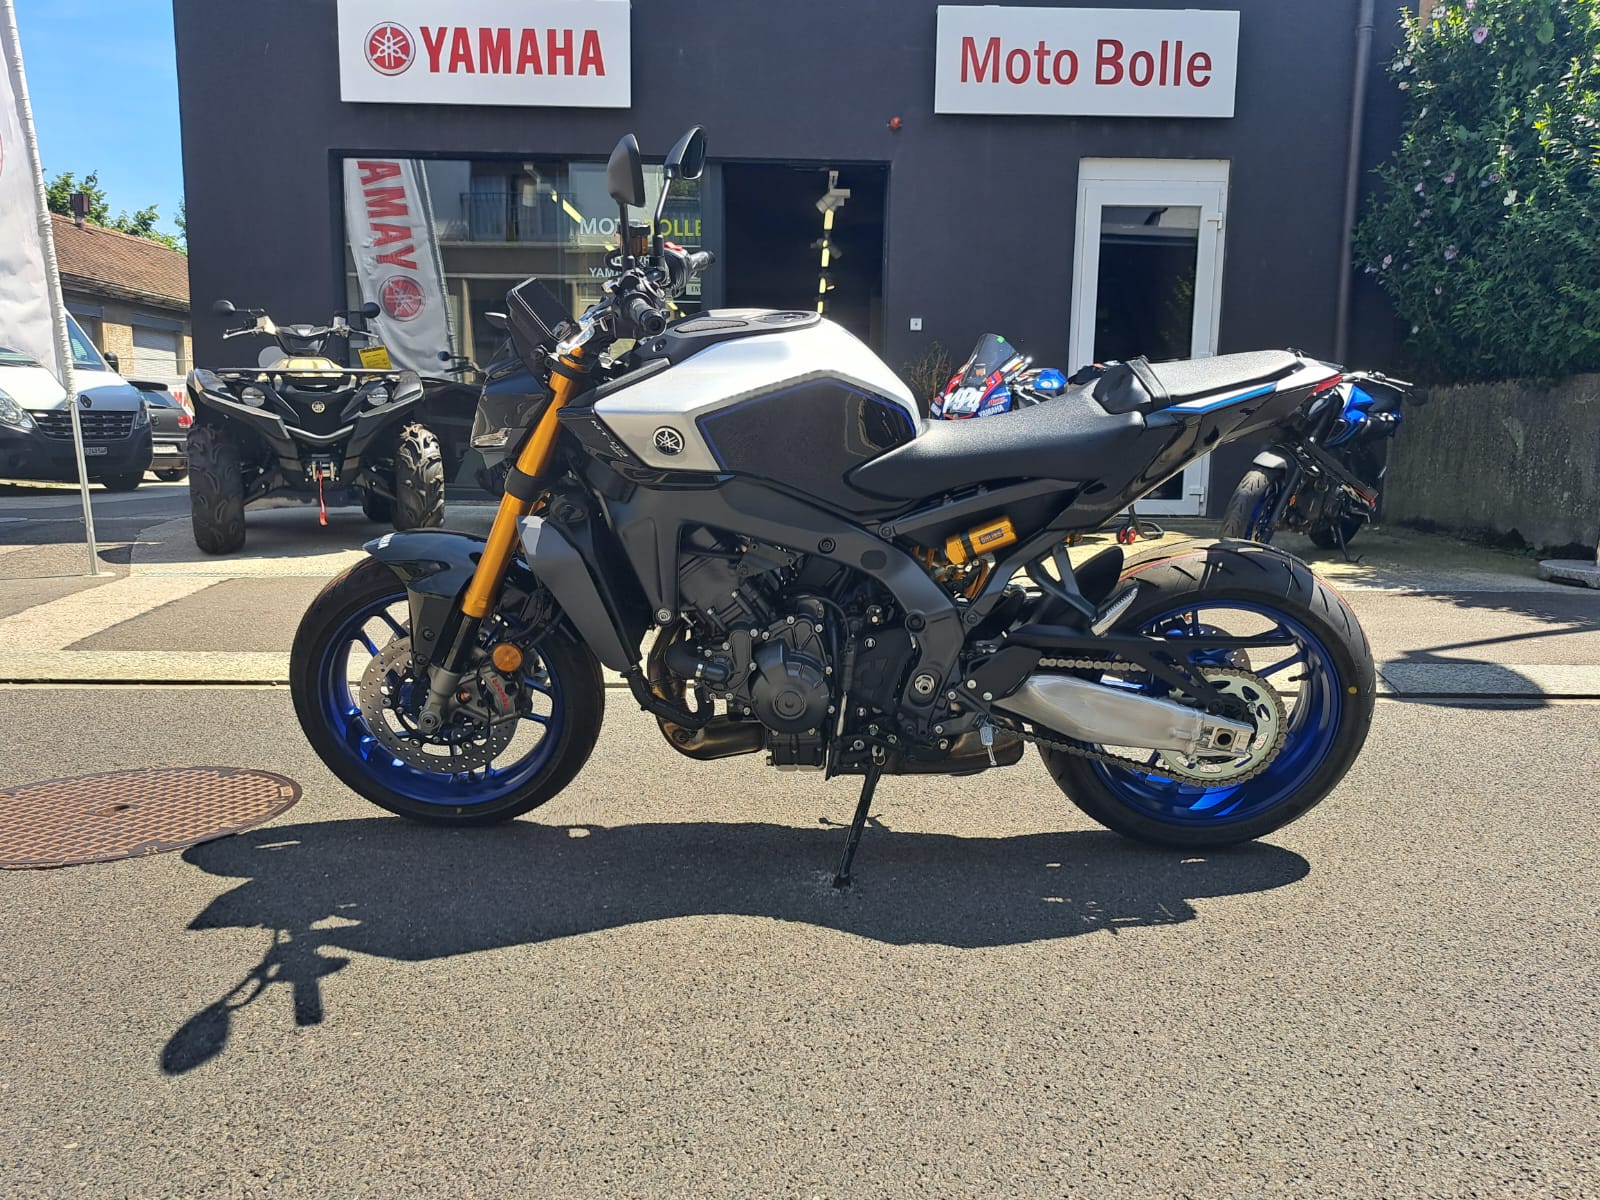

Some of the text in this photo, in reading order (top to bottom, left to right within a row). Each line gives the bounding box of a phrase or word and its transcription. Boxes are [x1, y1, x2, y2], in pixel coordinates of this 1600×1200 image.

[419, 26, 606, 76] YAMAHA
[960, 36, 1212, 87] Moto Bolle
